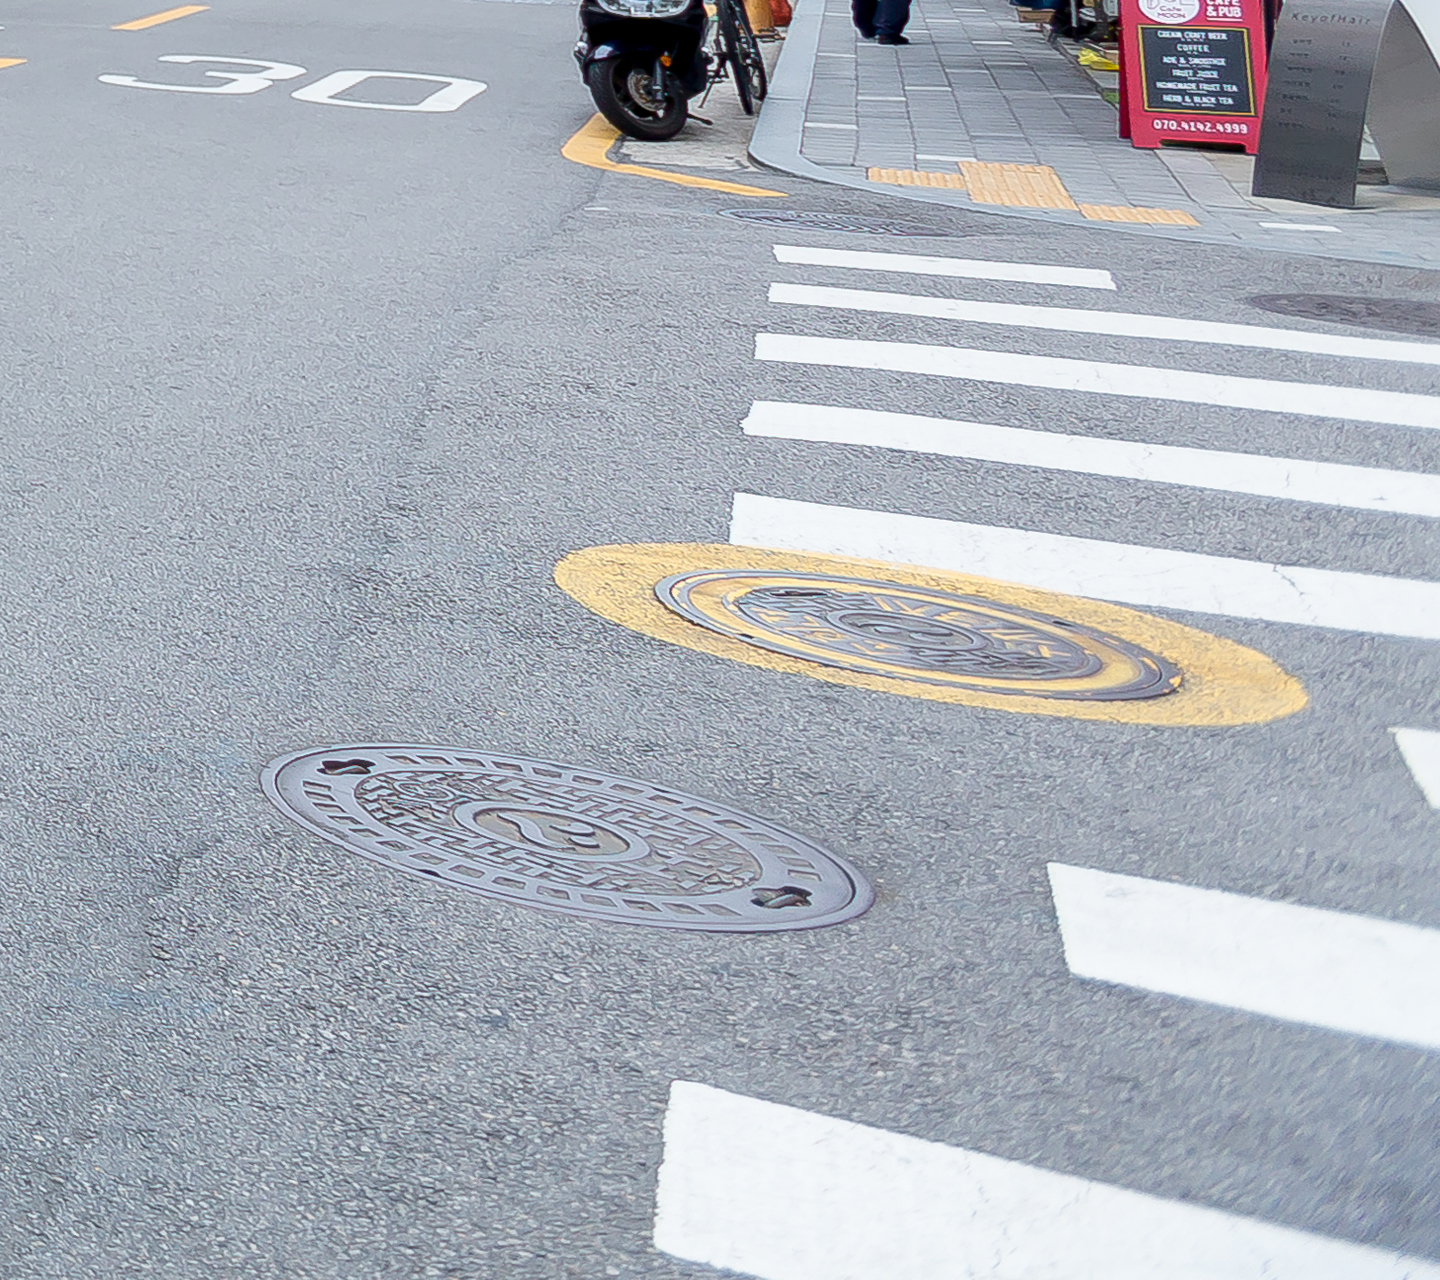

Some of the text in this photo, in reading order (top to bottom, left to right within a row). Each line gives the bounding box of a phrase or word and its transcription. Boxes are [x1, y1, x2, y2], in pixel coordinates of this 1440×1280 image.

[1219, 7, 1242, 18] PUB
[1176, 43, 1210, 53] COFFEE
[99, 54, 488, 112] 30
[1223, 83, 1239, 92] TEA
[1153, 119, 1248, 134] 070.4142.4999
